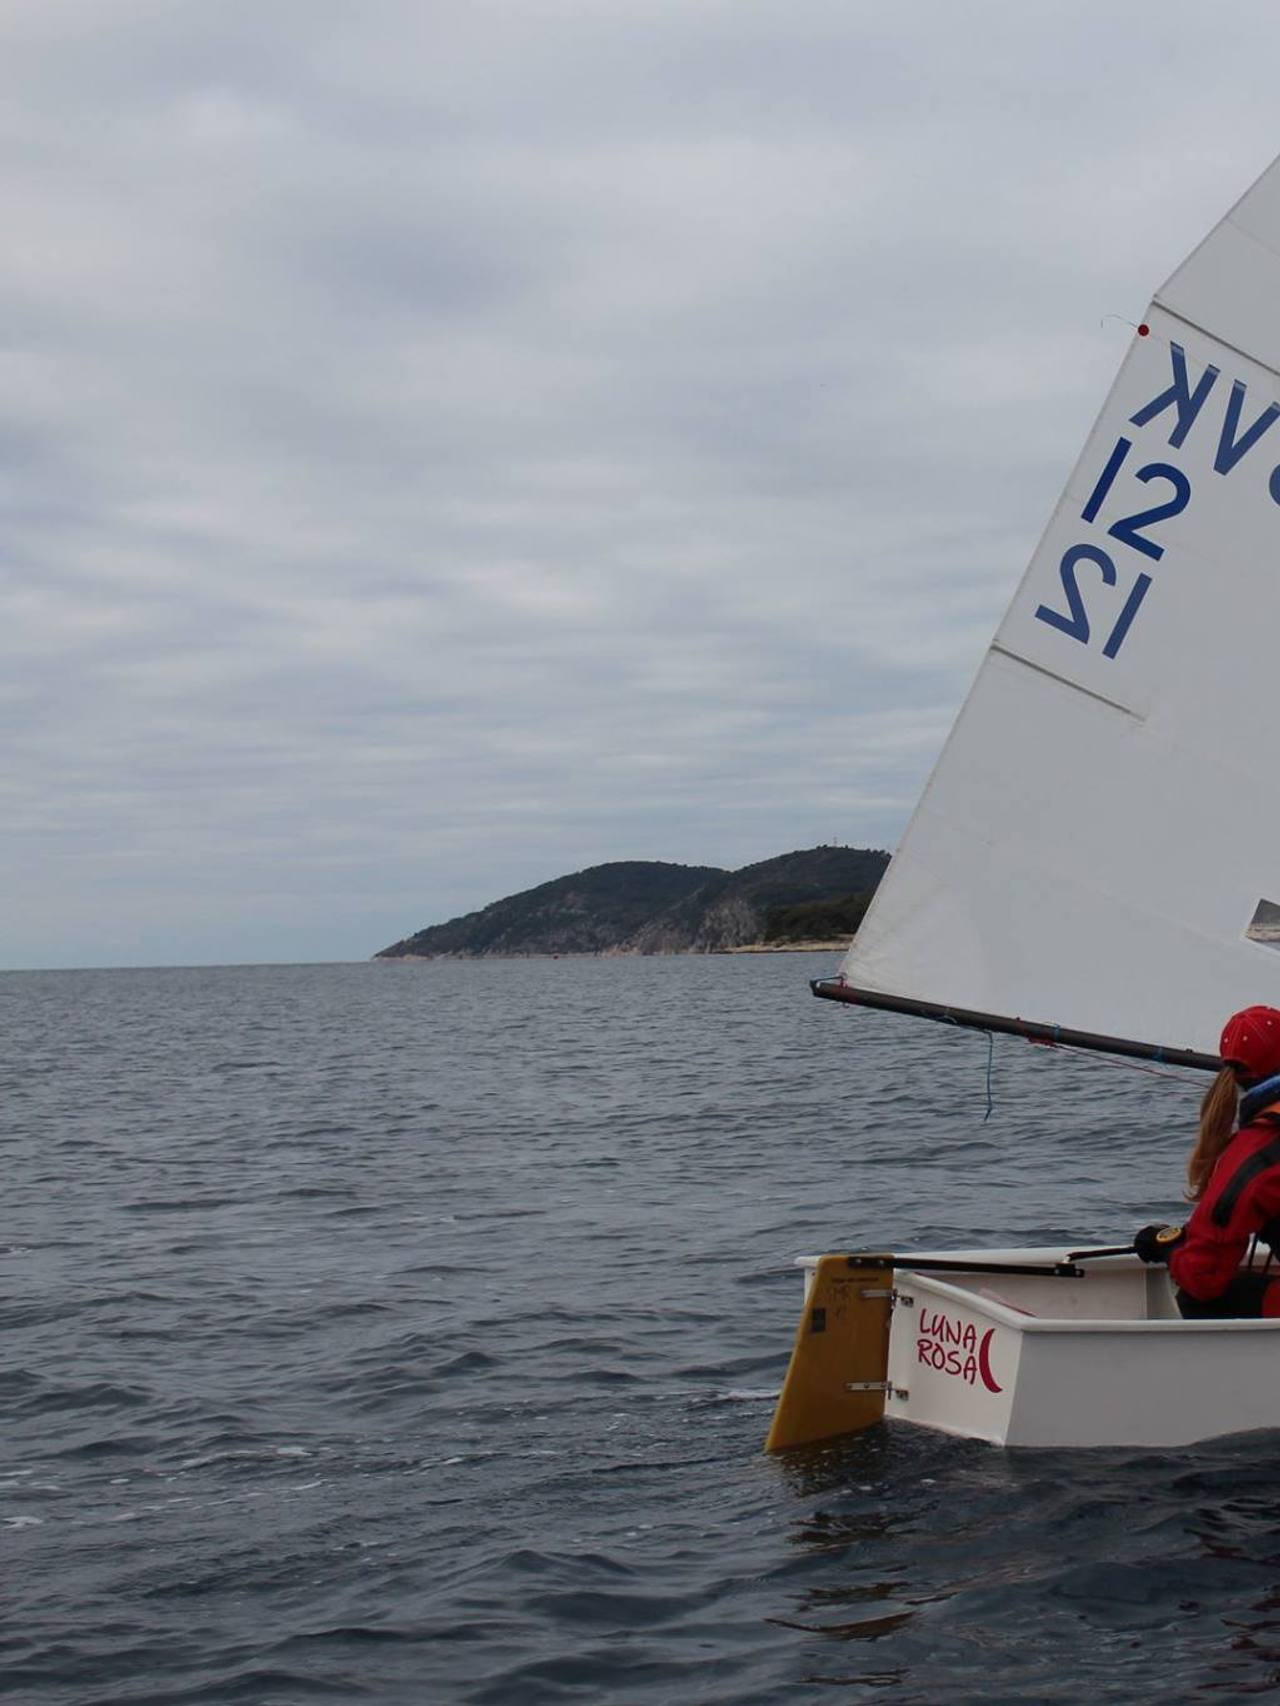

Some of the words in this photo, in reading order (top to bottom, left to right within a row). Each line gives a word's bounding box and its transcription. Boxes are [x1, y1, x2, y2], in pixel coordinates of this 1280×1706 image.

[1081, 437, 1192, 562] 12
[920, 1308, 977, 1354] LUNA
[917, 1339, 978, 1385] ROSA
